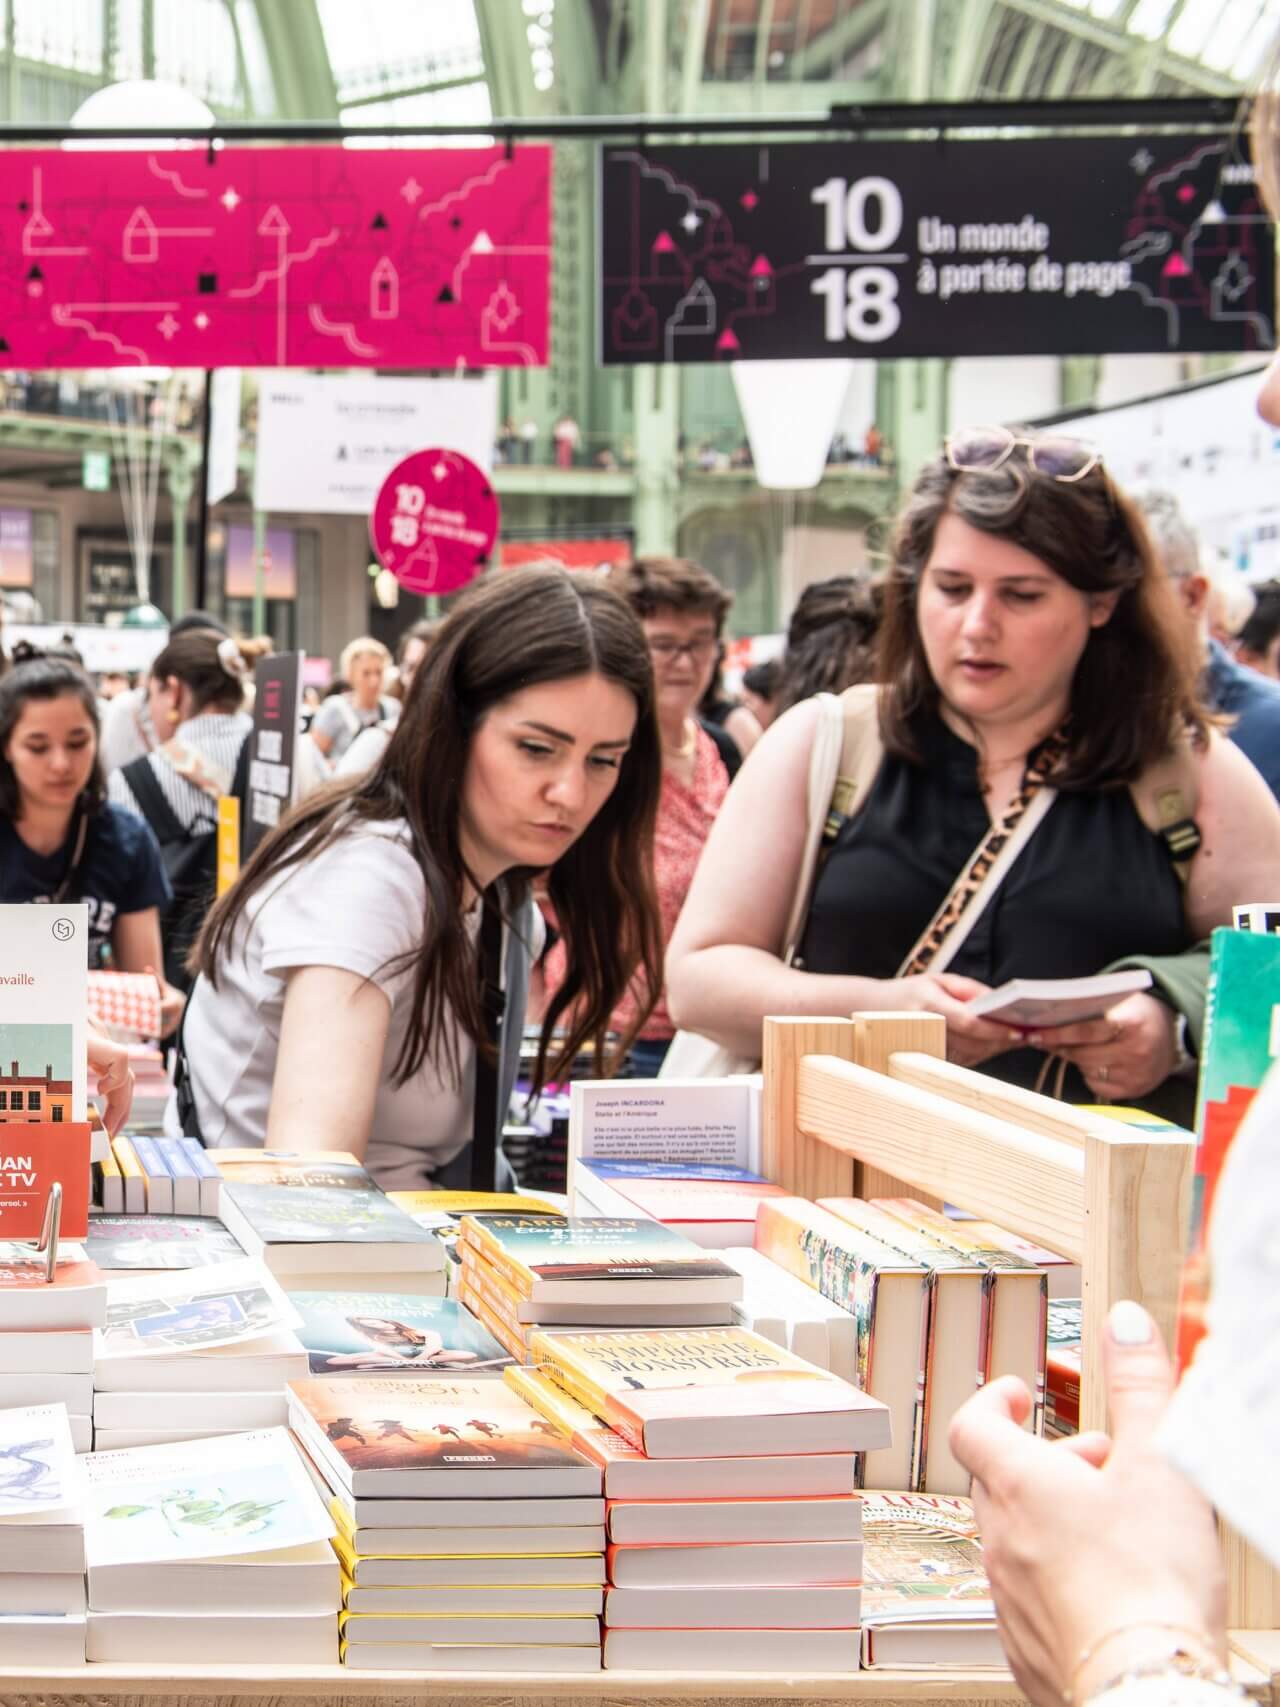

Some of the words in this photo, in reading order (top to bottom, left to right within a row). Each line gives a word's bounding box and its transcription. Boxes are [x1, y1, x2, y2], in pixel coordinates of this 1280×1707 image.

[810, 176, 904, 253] 10
[918, 217, 956, 254] Un
[959, 215, 1050, 252] monde
[917, 258, 937, 293] à
[940, 258, 1025, 299] portée
[1028, 256, 1061, 293] de
[1064, 259, 1133, 298] page
[810, 265, 903, 343] 18
[395, 483, 426, 515] 10
[390, 514, 419, 548] 18
[9, 1172, 38, 1188] TV
[494, 1219, 568, 1228] MARC
[577, 1219, 638, 1229] LEVY
[566, 1333, 651, 1345] MARC
[657, 1330, 730, 1342] LEVY
[583, 1343, 759, 1359] SYMPHONIE
[599, 1354, 780, 1372] MONSTRES
[880, 1494, 962, 1510] LEVY
